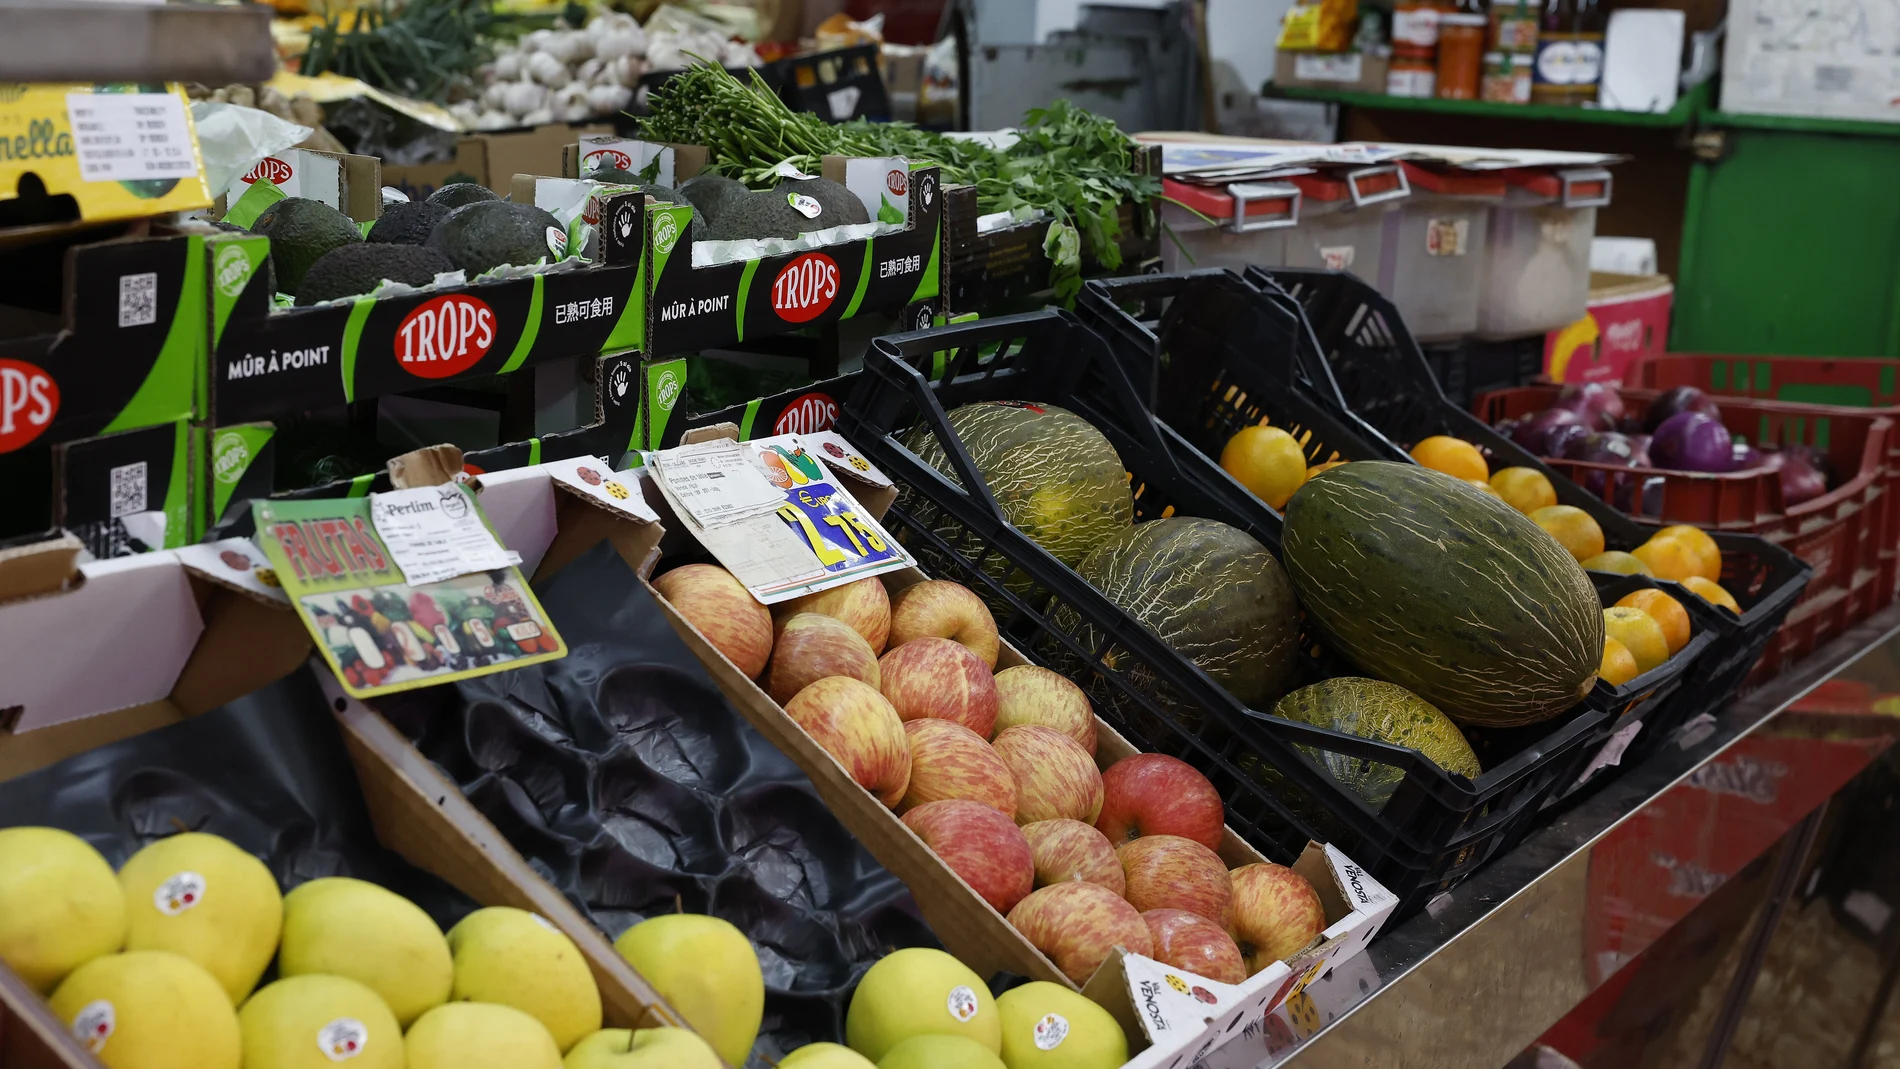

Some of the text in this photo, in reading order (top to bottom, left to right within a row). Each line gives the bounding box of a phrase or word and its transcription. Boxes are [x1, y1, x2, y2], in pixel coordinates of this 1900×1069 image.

[655, 223, 676, 246] TROPS
[879, 255, 921, 278] 已熟可食用
[775, 258, 836, 309] TROPS
[555, 296, 613, 324] 已熟可食用
[661, 295, 730, 322] MÛR À POINT
[400, 300, 493, 362] TROPS
[228, 346, 330, 380] MÛR À POINT
[658, 380, 679, 404] TROPS
[387, 501, 435, 516] Perlim
[274, 516, 387, 581] FRUTAS
[1343, 865, 1370, 904] VENOSTA
[1140, 980, 1166, 1031] VENOSTA
